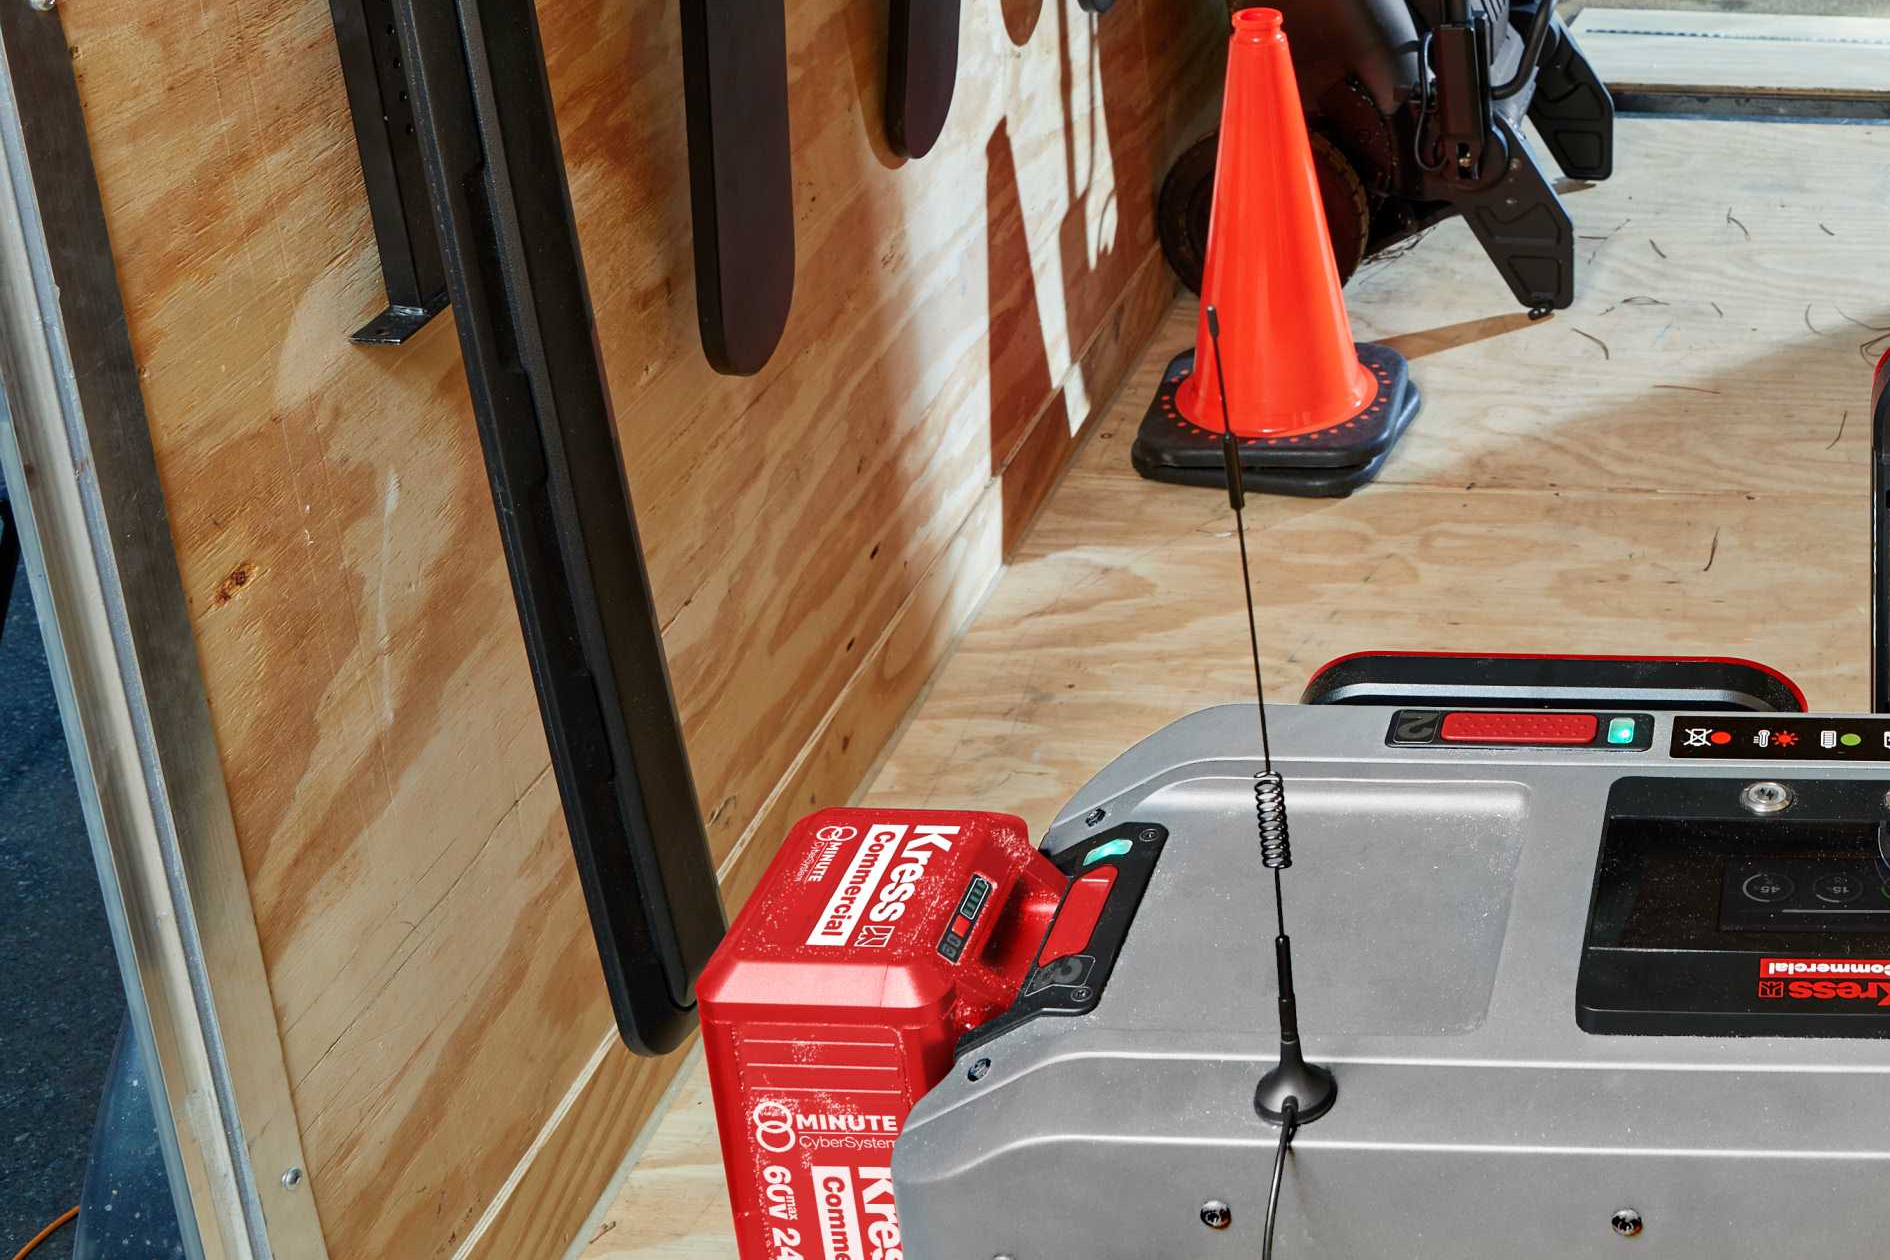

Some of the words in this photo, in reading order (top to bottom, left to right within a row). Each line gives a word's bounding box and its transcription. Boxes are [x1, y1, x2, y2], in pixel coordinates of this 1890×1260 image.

[808, 841, 844, 882] MINUTE
[820, 830, 896, 936] Commercial
[868, 825, 960, 922] Kress
[796, 1113, 898, 1131] MINUTE
